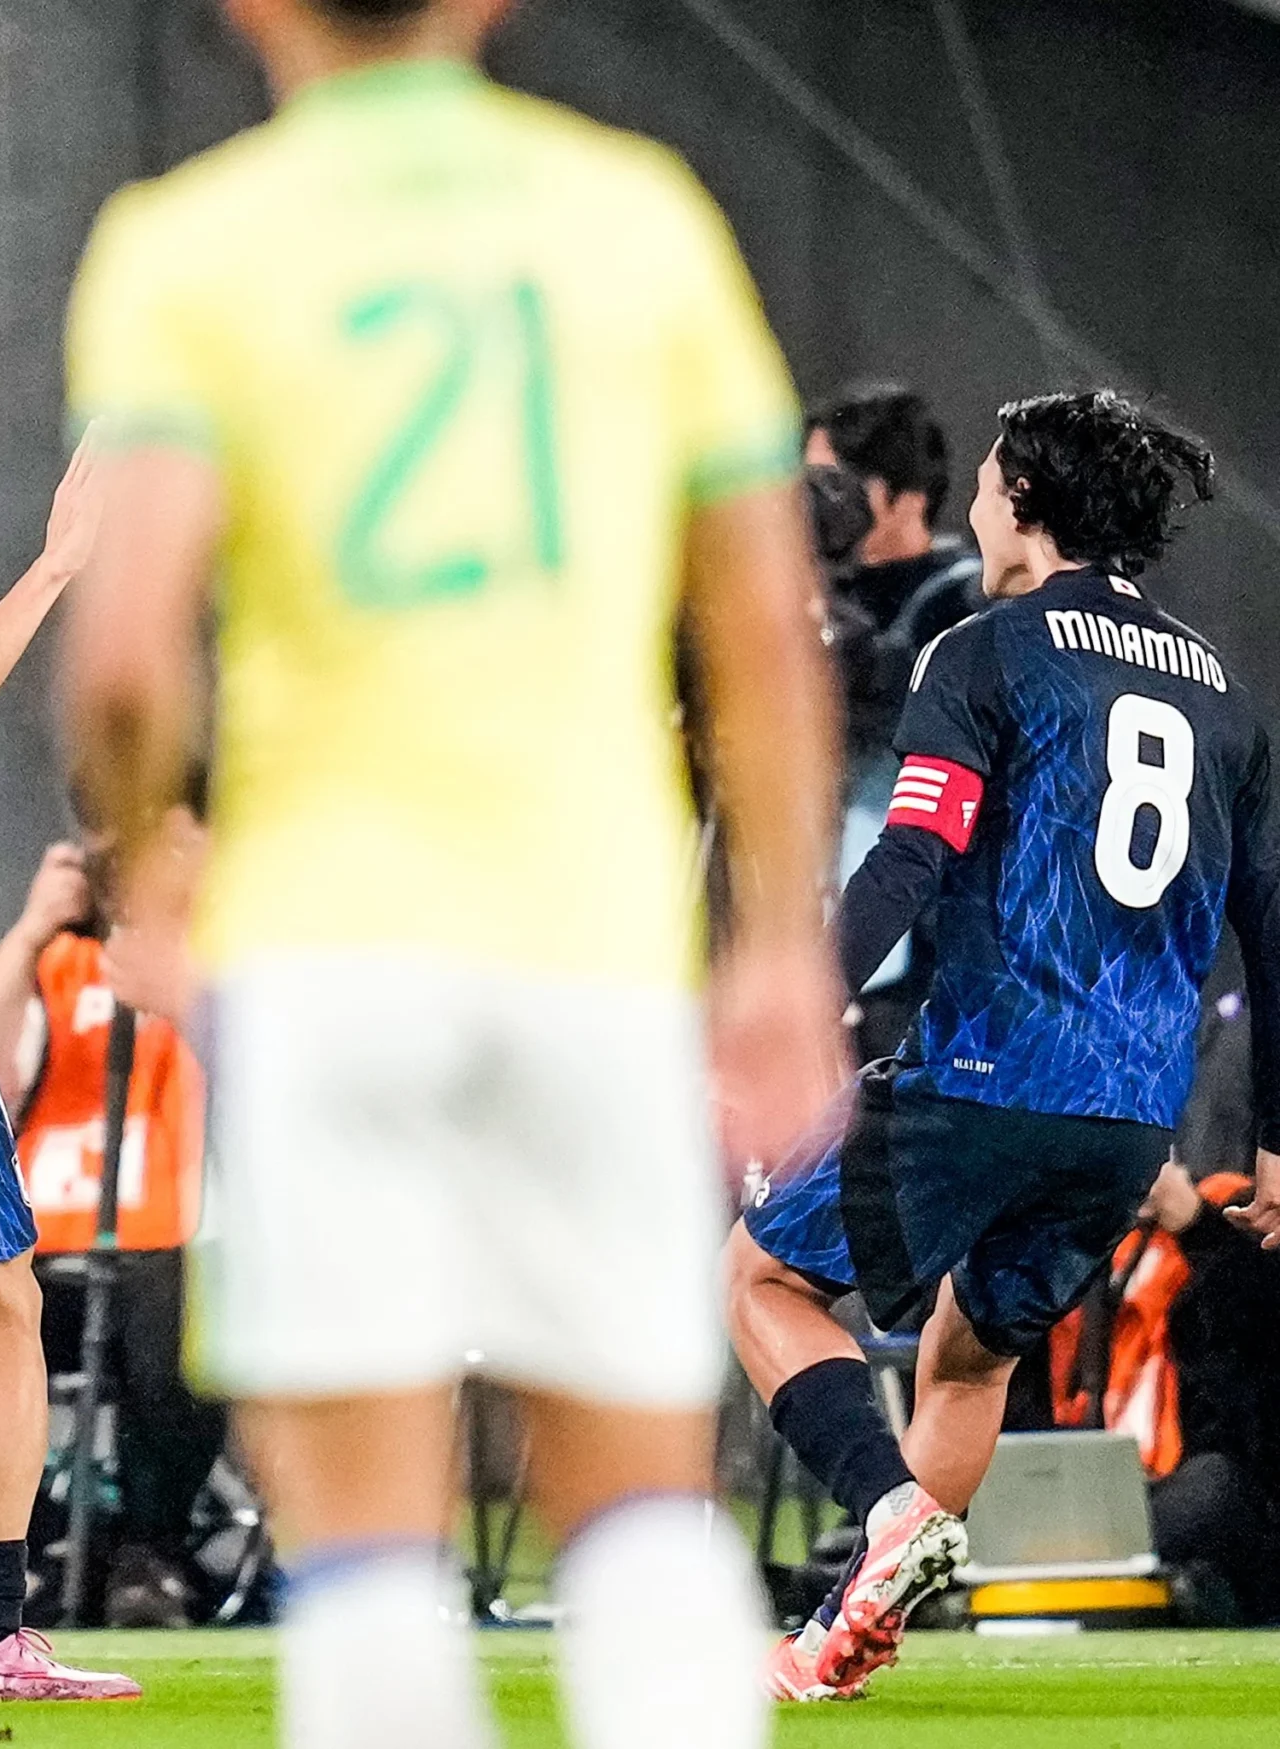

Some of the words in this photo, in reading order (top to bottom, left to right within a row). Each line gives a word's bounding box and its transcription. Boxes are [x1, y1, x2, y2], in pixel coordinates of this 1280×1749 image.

[339, 272, 565, 604] 21
[1044, 609, 1228, 693] MINAMINO
[1094, 692, 1195, 909] 8
